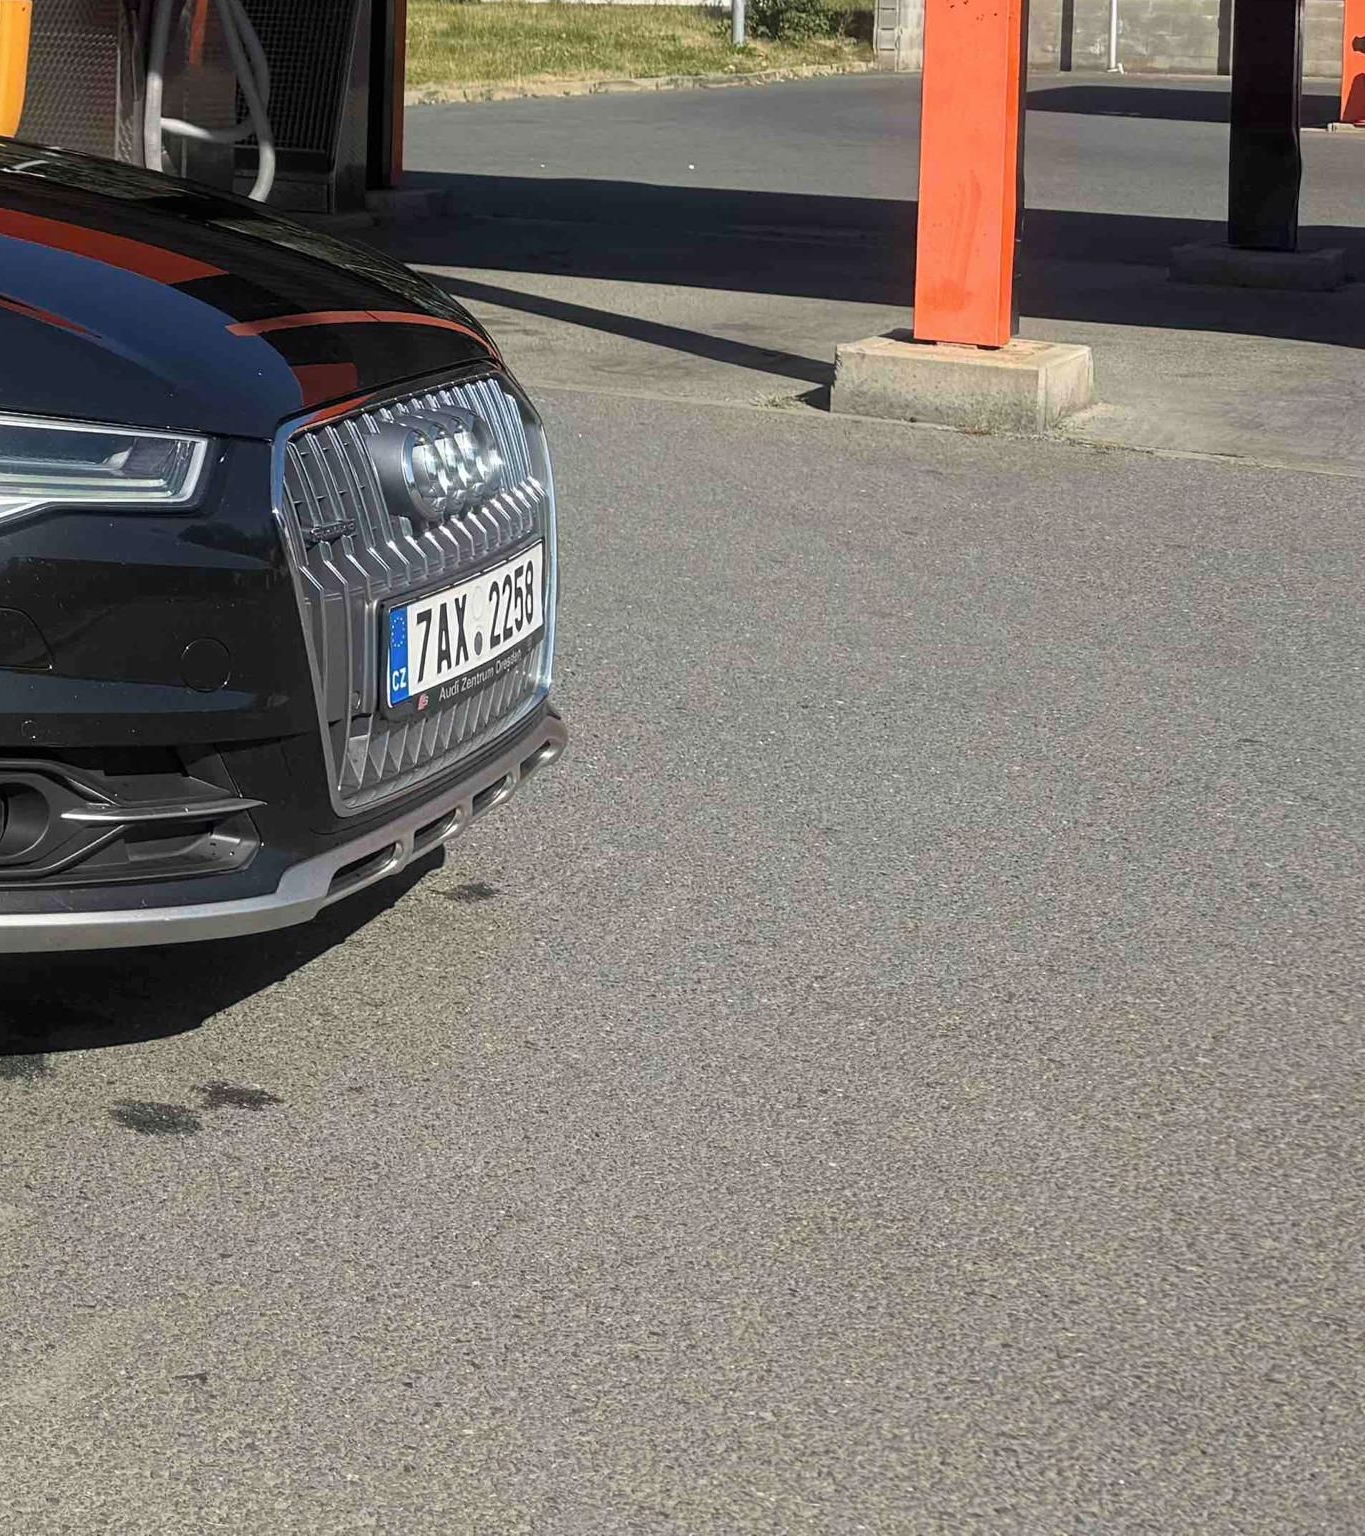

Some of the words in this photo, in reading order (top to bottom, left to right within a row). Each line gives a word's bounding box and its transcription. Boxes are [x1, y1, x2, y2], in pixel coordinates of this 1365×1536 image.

[416, 593, 469, 683] 7AX
[488, 560, 534, 650] 2258
[392, 668, 407, 691] CZ
[438, 680, 460, 702] Audi
[461, 666, 494, 692] Zentrum
